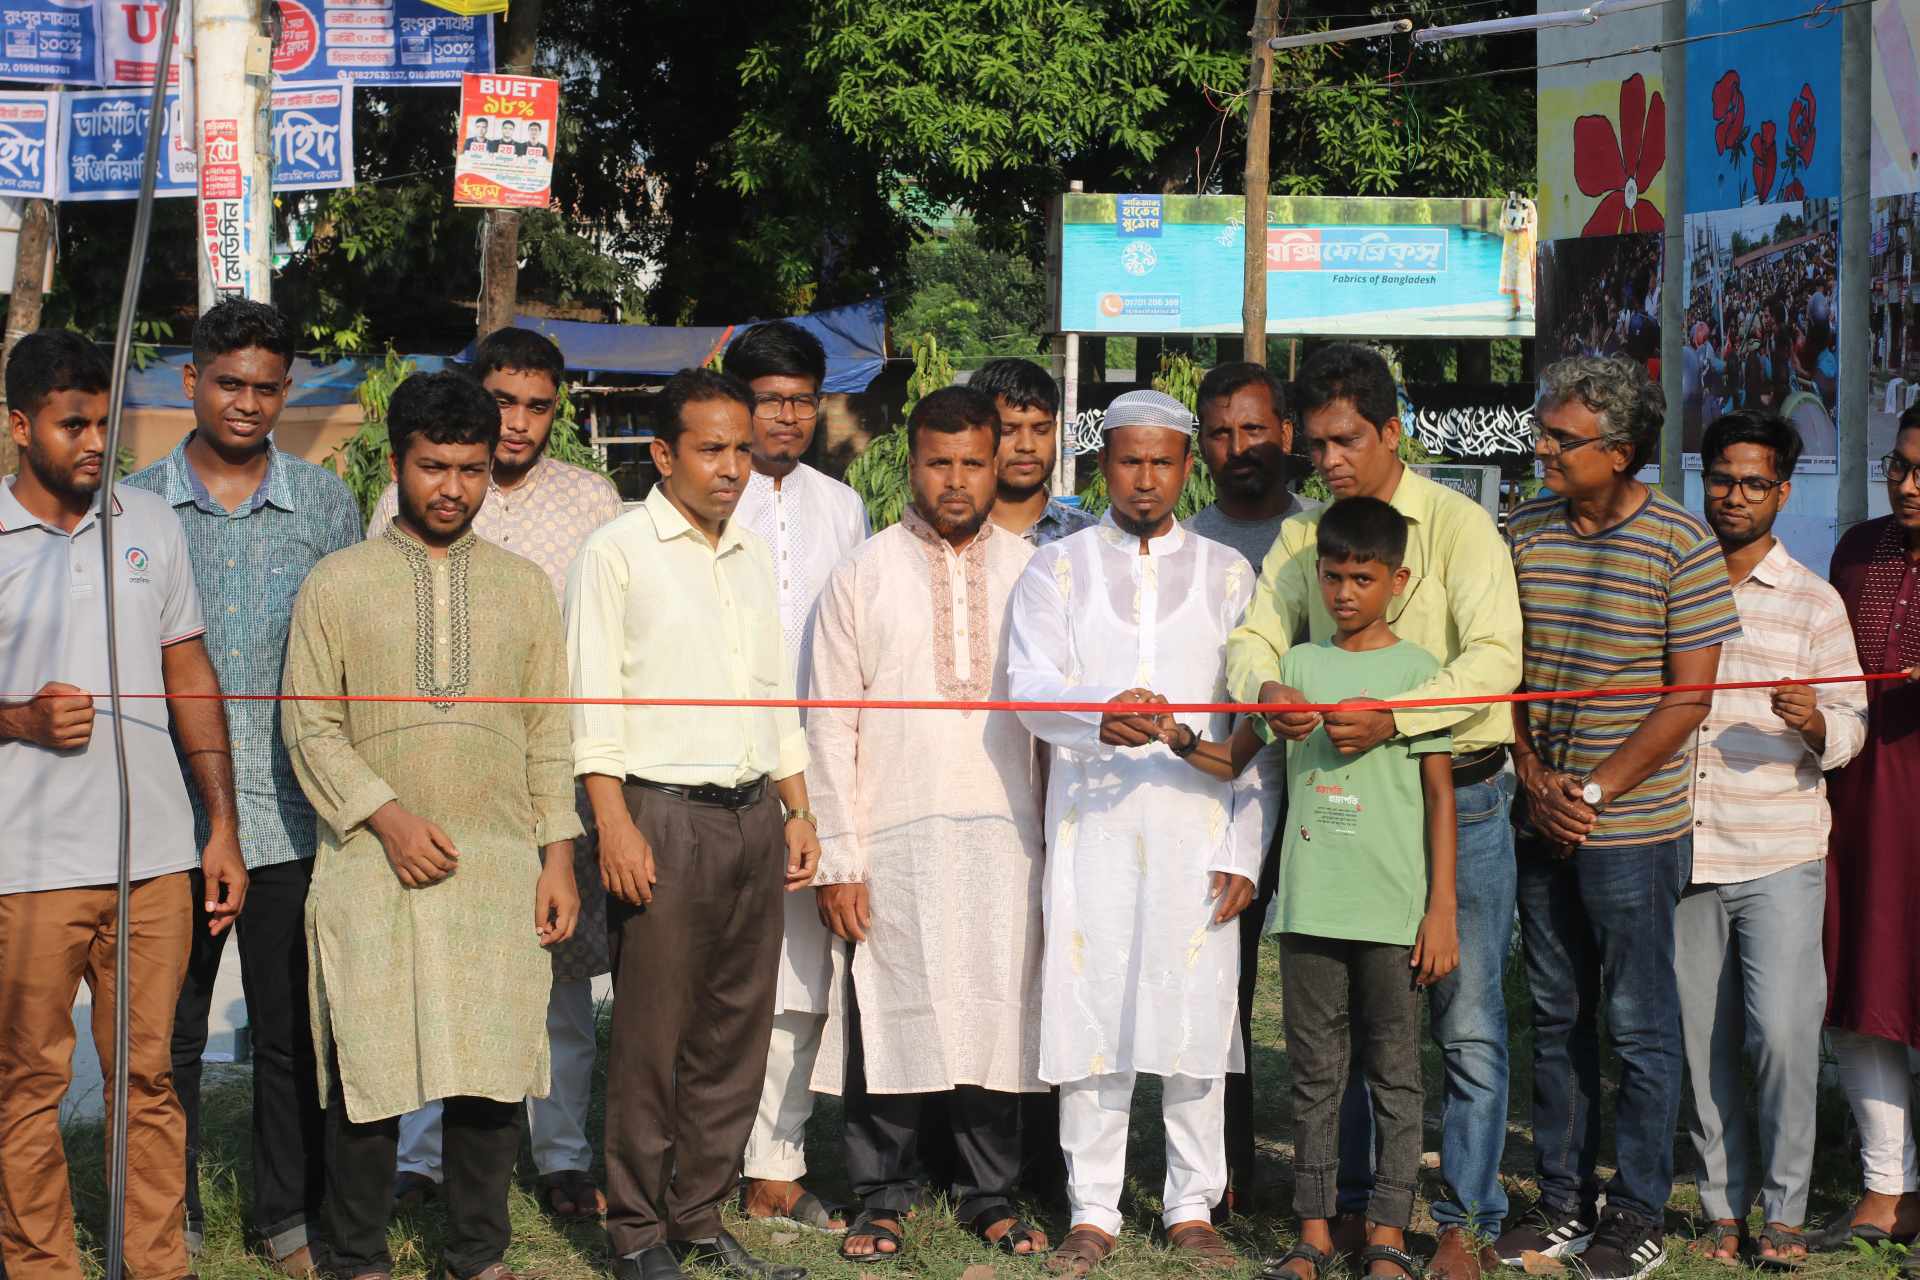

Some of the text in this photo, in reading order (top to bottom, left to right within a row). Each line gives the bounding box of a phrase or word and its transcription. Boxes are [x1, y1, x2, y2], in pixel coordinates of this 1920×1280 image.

[3, 10, 40, 30] রংপুর
[400, 17, 436, 36] রংপুর
[39, 38, 82, 52] ১০০%
[433, 42, 476, 56] ১০০%
[480, 79, 543, 98] BUET
[484, 95, 535, 117] ৯৮%
[1122, 207, 1160, 219] হাতের
[218, 201, 242, 284] মেডিসিন
[1332, 273, 1437, 286] Fabrics of Bangladesh
